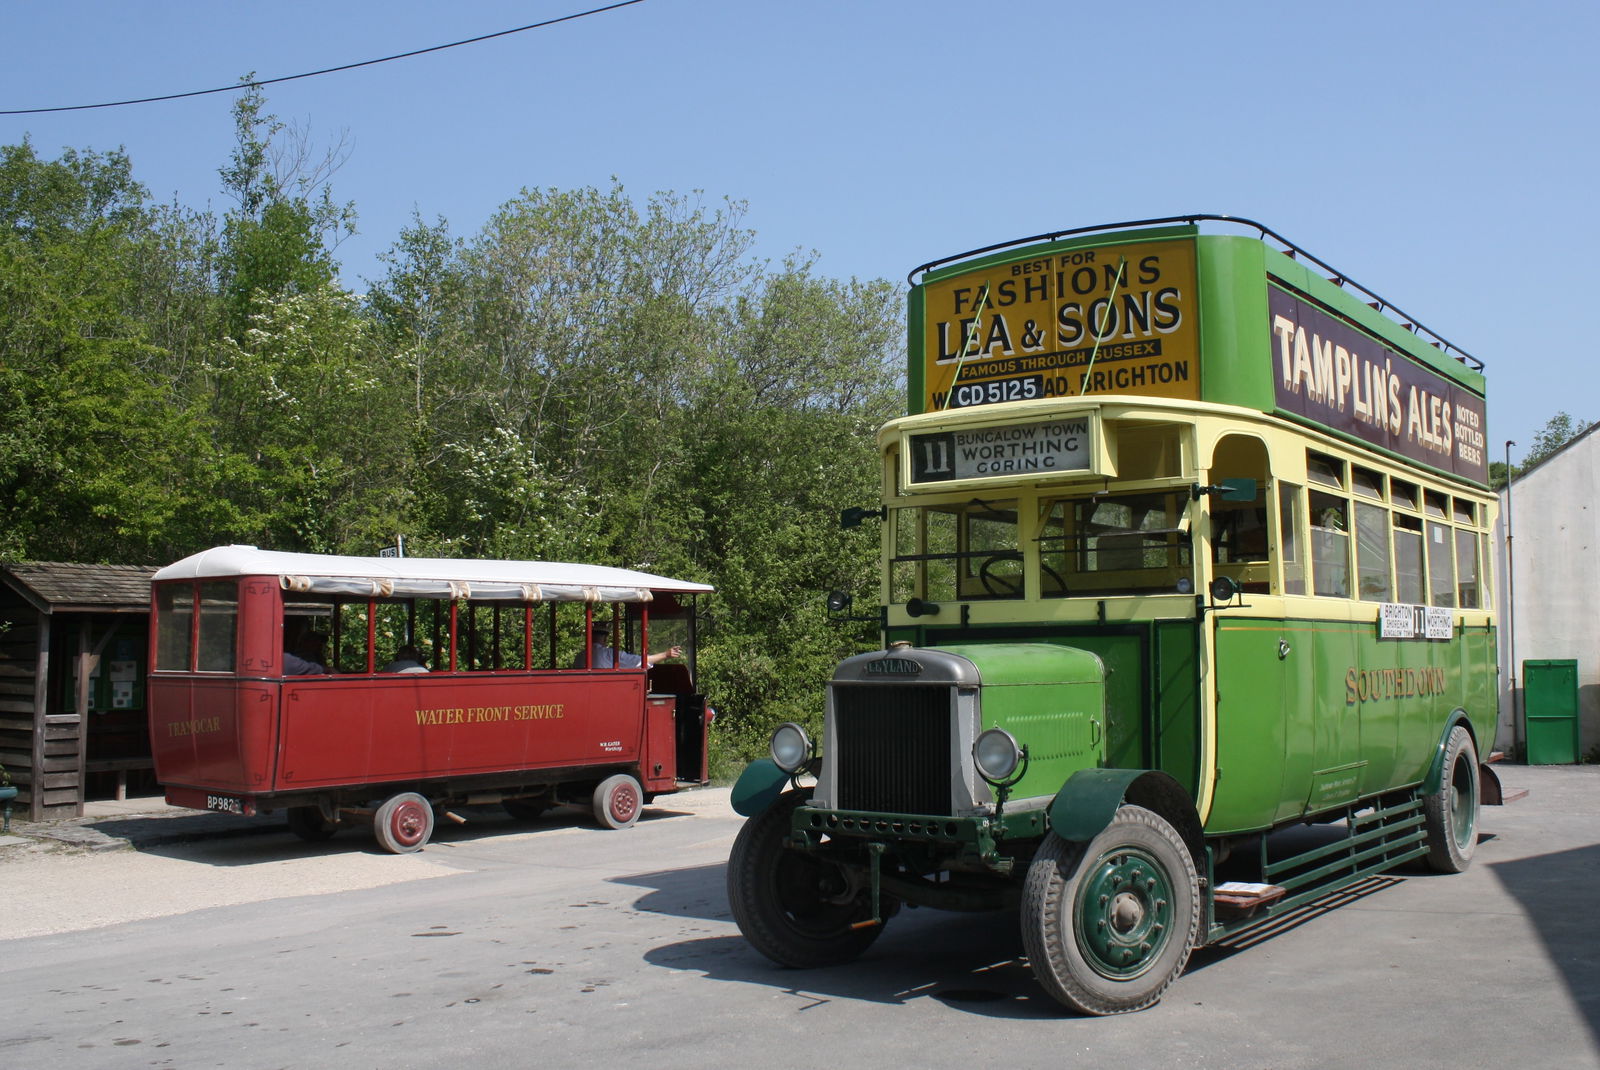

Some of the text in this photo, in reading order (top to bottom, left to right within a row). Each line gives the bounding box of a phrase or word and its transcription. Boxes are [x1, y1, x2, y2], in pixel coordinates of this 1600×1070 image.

[1011, 251, 1096, 277] BEST FOR
[953, 255, 1161, 315] FASHIONS
[935, 287, 1182, 366] LEA & SONS
[961, 342, 1156, 378] FAMOUS THROUGH SUSSEX
[1081, 360, 1189, 394] BRIGHTON
[1273, 314, 1452, 457] TAMPLIN'S ALES
[957, 385, 984, 406] CD
[987, 378, 1037, 403] 5125
[1456, 404, 1479, 428] NOTED
[1454, 421, 1484, 448] BOTTLED
[922, 423, 1087, 474] 11 BUNGALOW TOWN
[962, 437, 1079, 461] WORTHING
[1458, 442, 1481, 467] BEERS
[976, 457, 1056, 474] GORING
[382, 549, 396, 558] BUS
[1384, 604, 1412, 619] BRIGHTON
[1414, 609, 1425, 634] 11
[1427, 615, 1451, 628] WORTHING
[1429, 629, 1448, 637] GORING
[868, 660, 919, 673] LEYLAND
[1344, 667, 1447, 705] SOUTHDOWN
[168, 716, 221, 737] TRAMOCAR
[415, 704, 564, 726] WATER FRONT SERVICE
